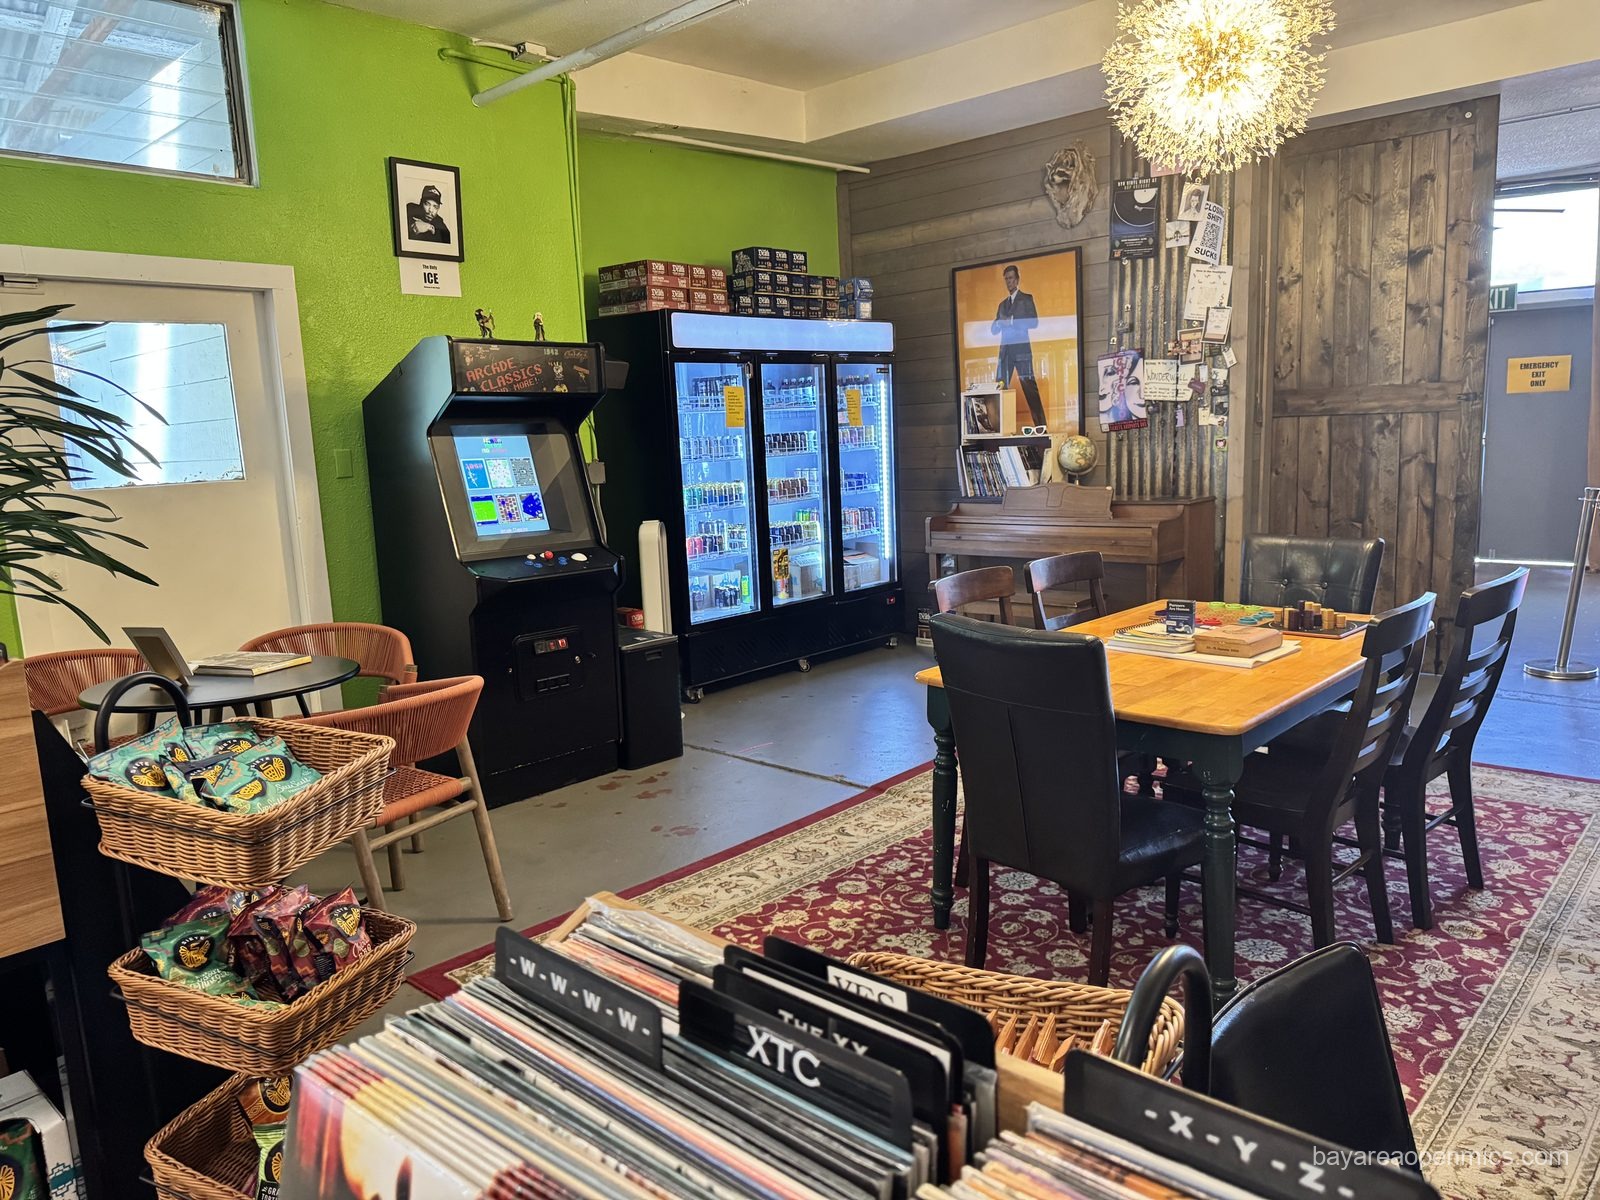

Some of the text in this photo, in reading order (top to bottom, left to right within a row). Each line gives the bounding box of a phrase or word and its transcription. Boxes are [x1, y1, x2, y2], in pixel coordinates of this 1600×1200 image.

[1207, 212, 1222, 224] SHIFT
[1194, 246, 1217, 260] SUCKS
[423, 272, 439, 284] ICE
[466, 357, 517, 382] ARCADE
[1520, 361, 1559, 370] EMERGENCY
[480, 363, 543, 392] CLASSICS
[181, 936, 205, 945] SIETE
[746, 1024, 821, 1088] XTC
